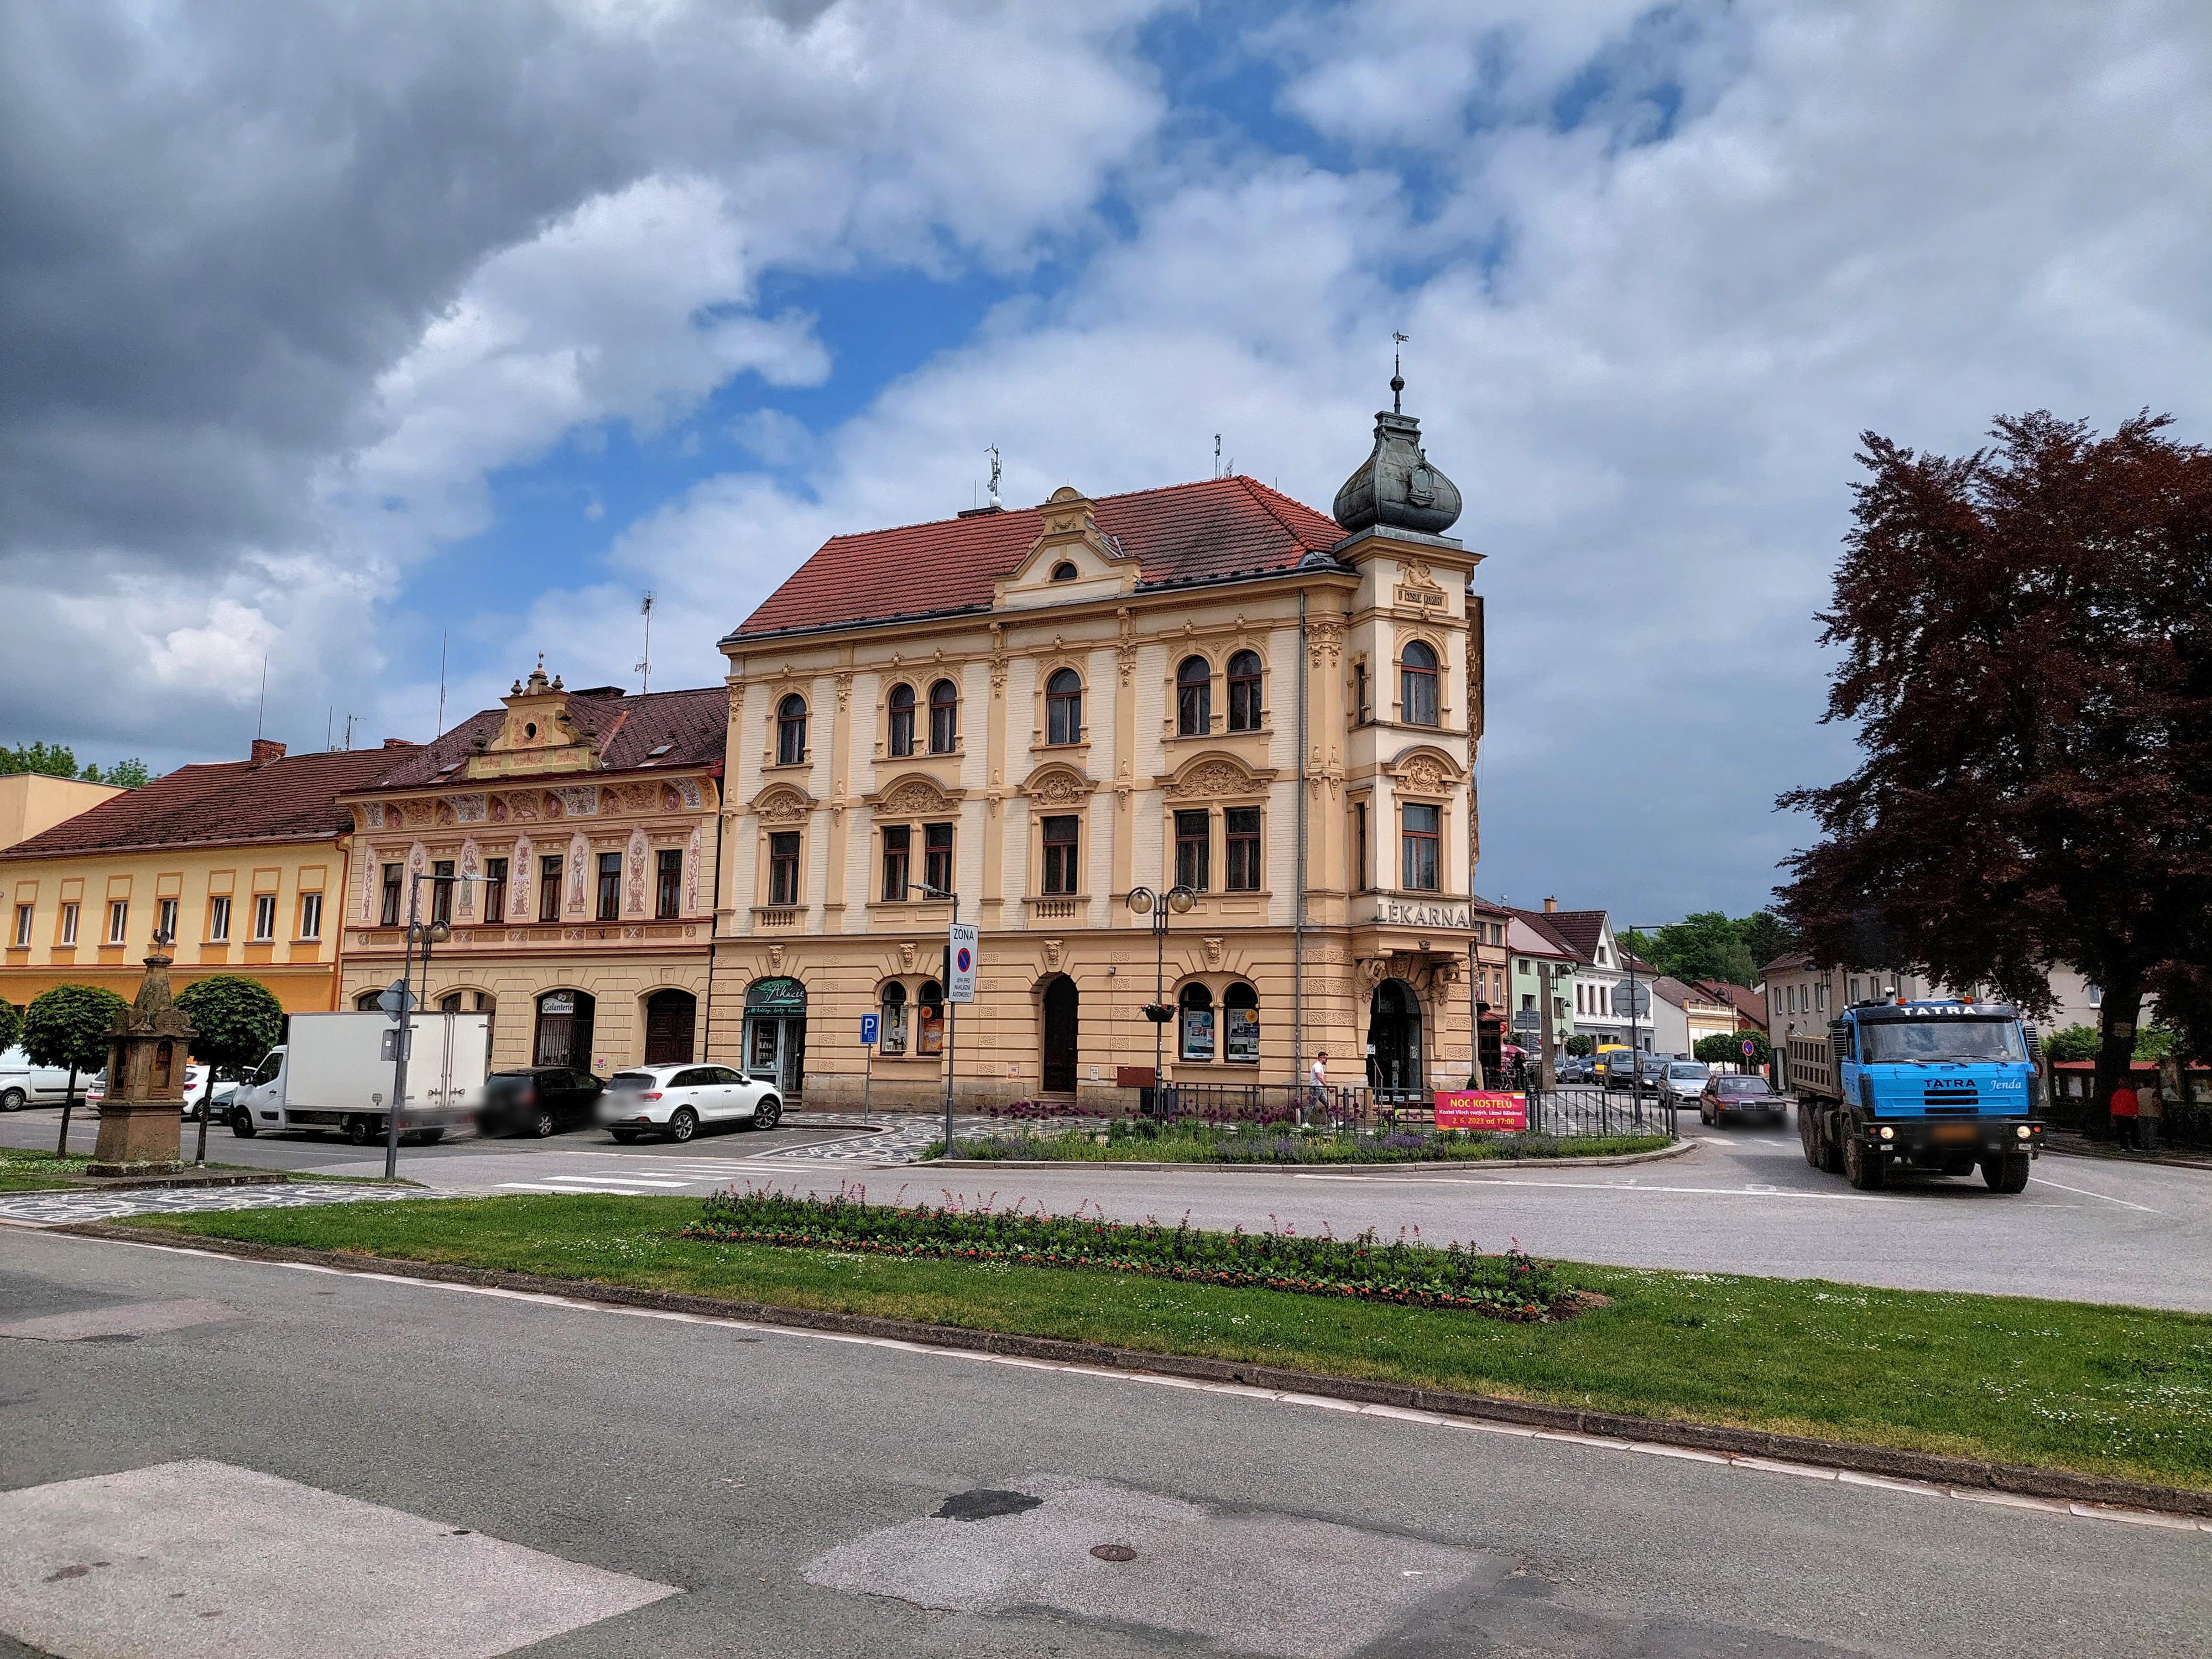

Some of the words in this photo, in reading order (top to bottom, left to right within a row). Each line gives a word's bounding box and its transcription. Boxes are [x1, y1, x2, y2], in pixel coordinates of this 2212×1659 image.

[1398, 591, 1402, 601] U
[1378, 900, 1469, 927] LÉKÁRNA
[953, 926, 974, 941] ZÓNA
[767, 983, 805, 1001] Akácie
[543, 1003, 573, 1012] Galanterie
[1900, 1006, 1977, 1016] TATRA
[864, 1018, 874, 1034] P
[1924, 1079, 1976, 1088] TATRA
[1989, 1078, 2022, 1091] Jenda
[1450, 1099, 1470, 1108] NOC
[1473, 1097, 1512, 1108] KOSTELŮ
